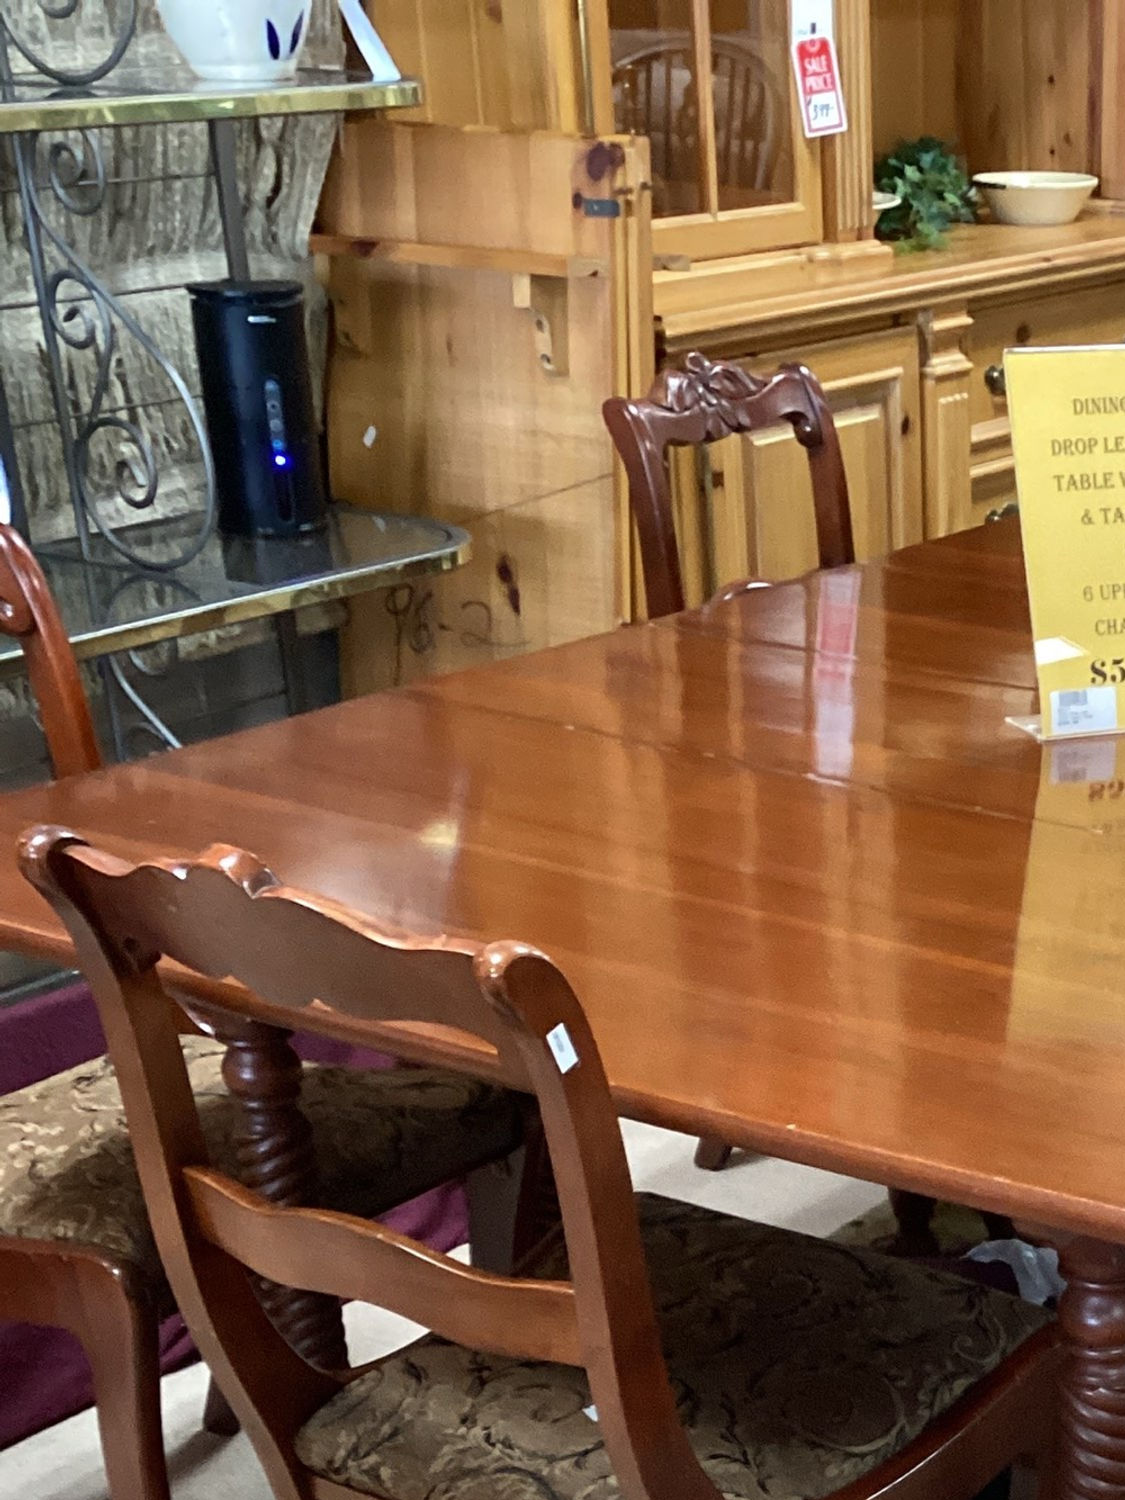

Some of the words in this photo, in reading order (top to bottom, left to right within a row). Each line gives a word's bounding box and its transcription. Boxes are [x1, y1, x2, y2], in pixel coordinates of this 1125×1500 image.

[1050, 437, 1098, 456] DROP
[1054, 472, 1115, 492] TABLE
[1081, 509, 1095, 525] &
[1083, 585, 1094, 602] 6
